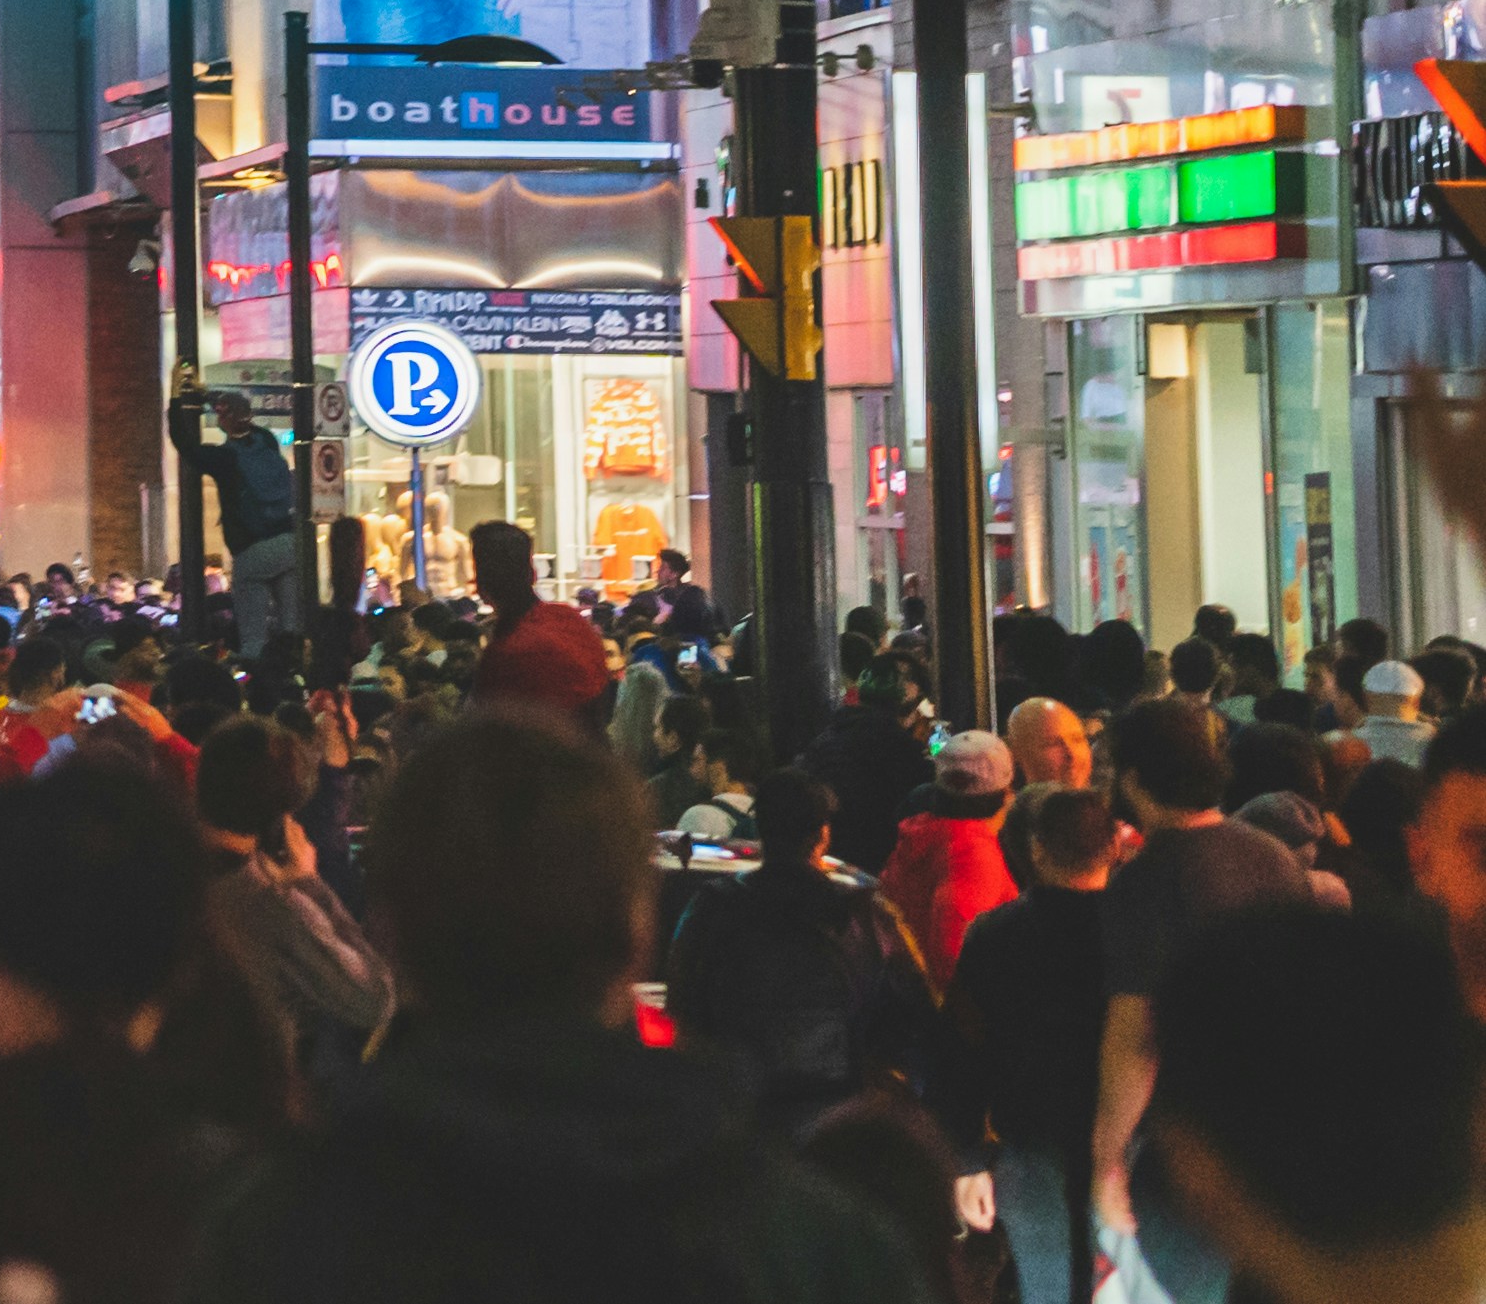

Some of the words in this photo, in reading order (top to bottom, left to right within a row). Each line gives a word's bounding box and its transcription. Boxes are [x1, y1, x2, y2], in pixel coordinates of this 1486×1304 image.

[330, 92, 637, 127] boathouse
[453, 314, 511, 332] CALVIN
[513, 315, 560, 333] KLEIN
[385, 348, 440, 418] P
